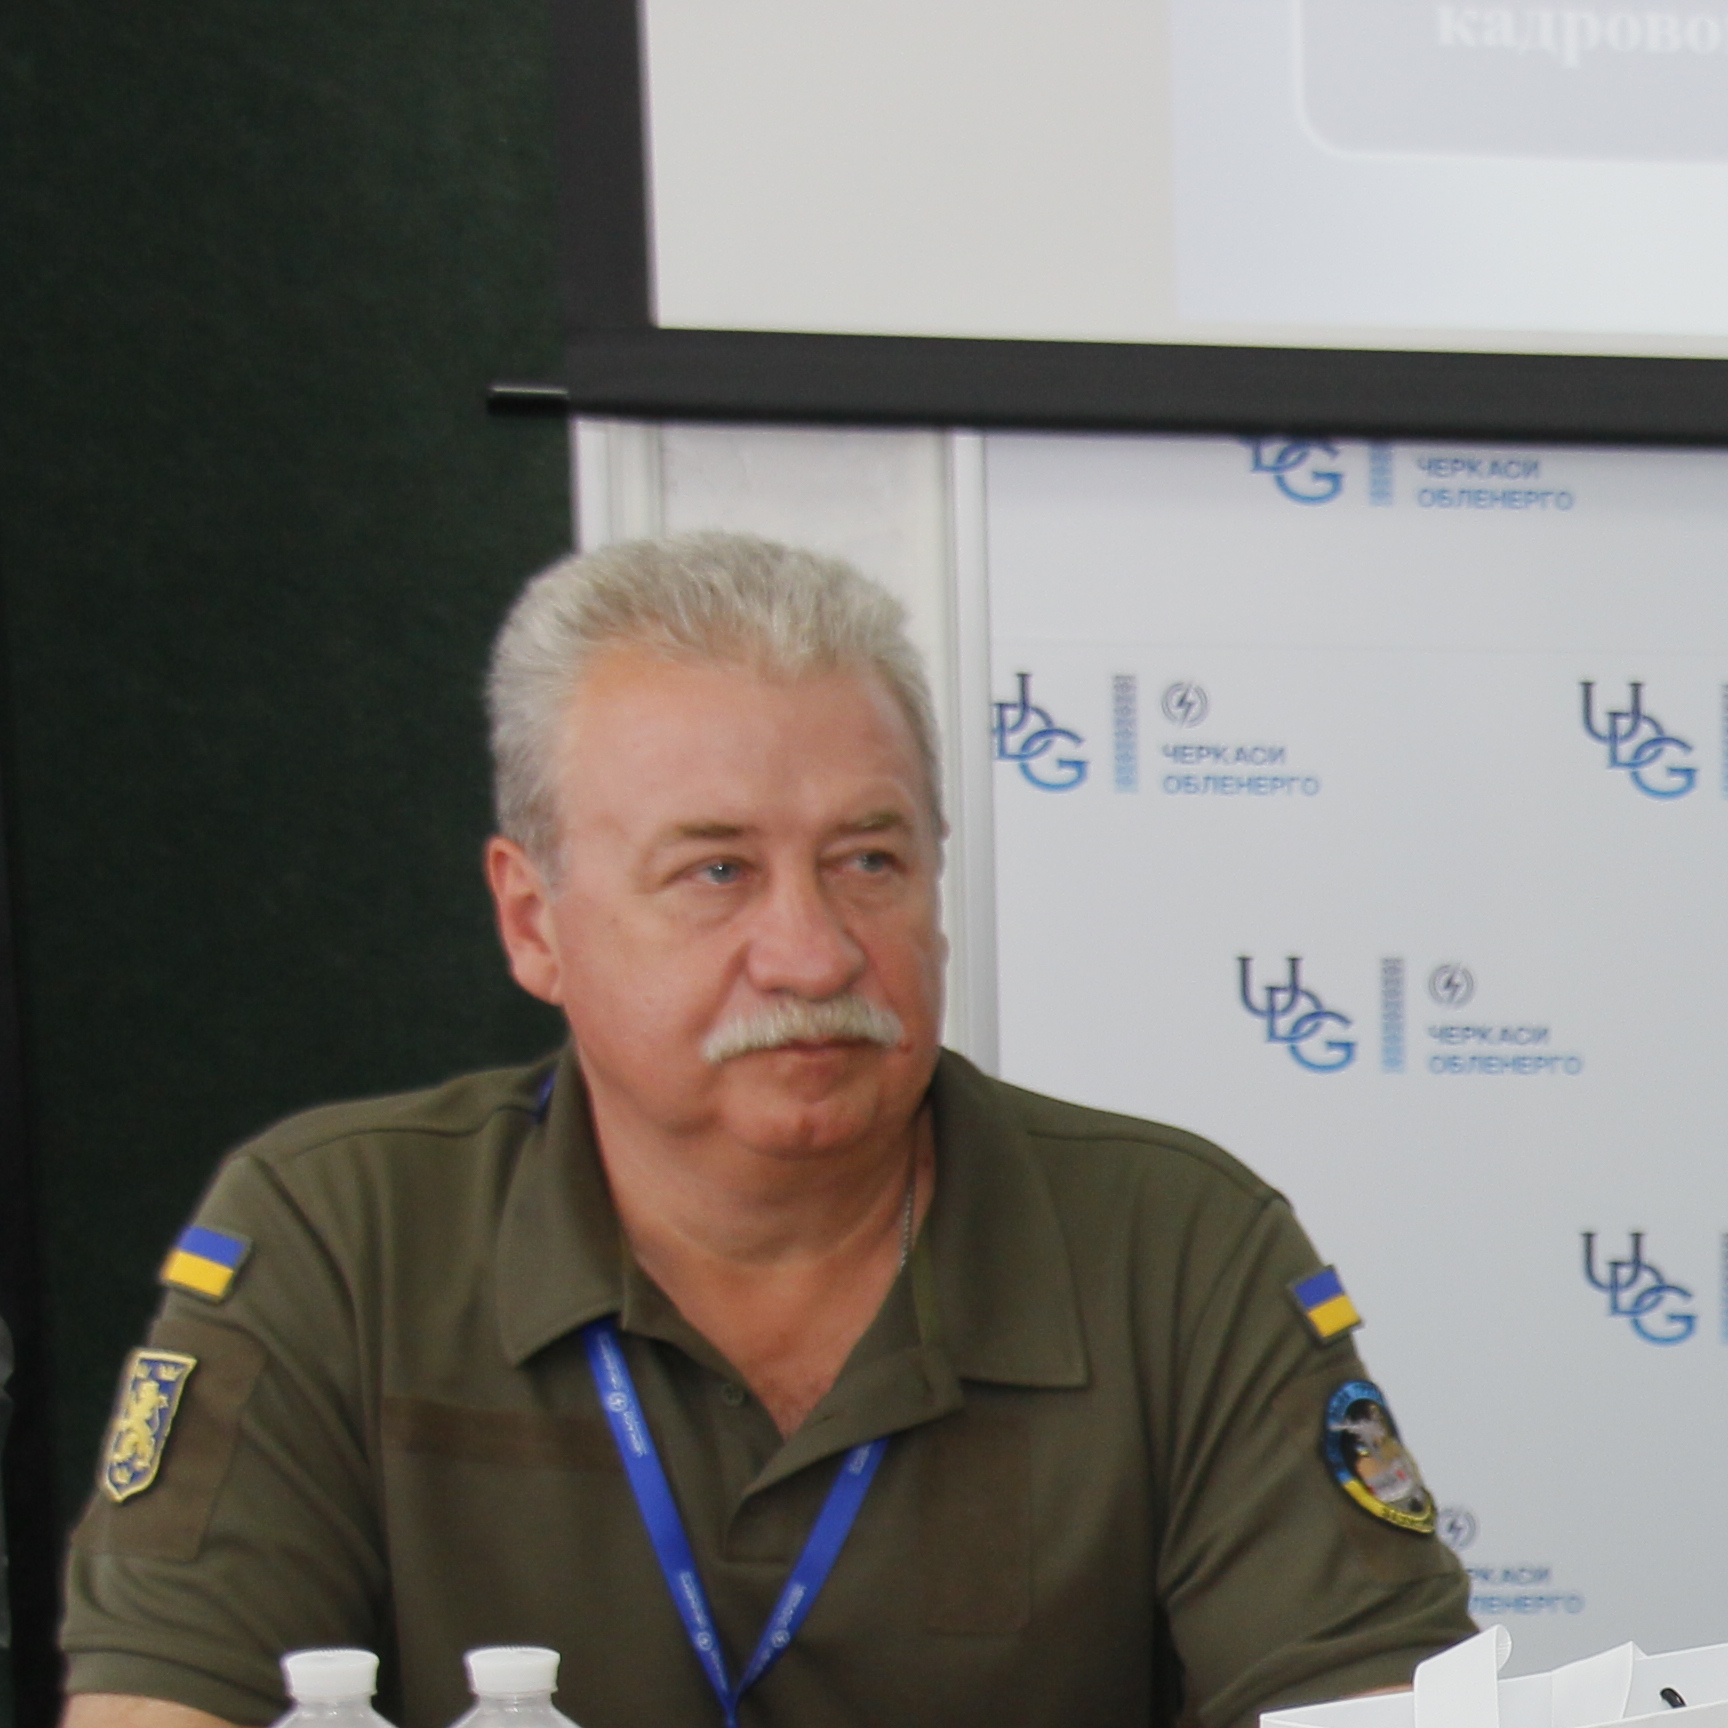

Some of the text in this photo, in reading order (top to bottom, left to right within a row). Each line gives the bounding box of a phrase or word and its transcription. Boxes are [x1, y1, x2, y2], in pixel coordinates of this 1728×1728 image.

[1417, 459, 1541, 480] ЧЕРКАСИ
[1418, 488, 1574, 511] ОБЛЕНЕРГО
[1162, 744, 1286, 765] ЧЕРКАСИ
[1162, 774, 1320, 796] ОБЛЕНЕРГО
[1428, 1025, 1550, 1046] ЧЕРКАСИ
[1428, 1054, 1582, 1075] ОБЛЕНЕРГО
